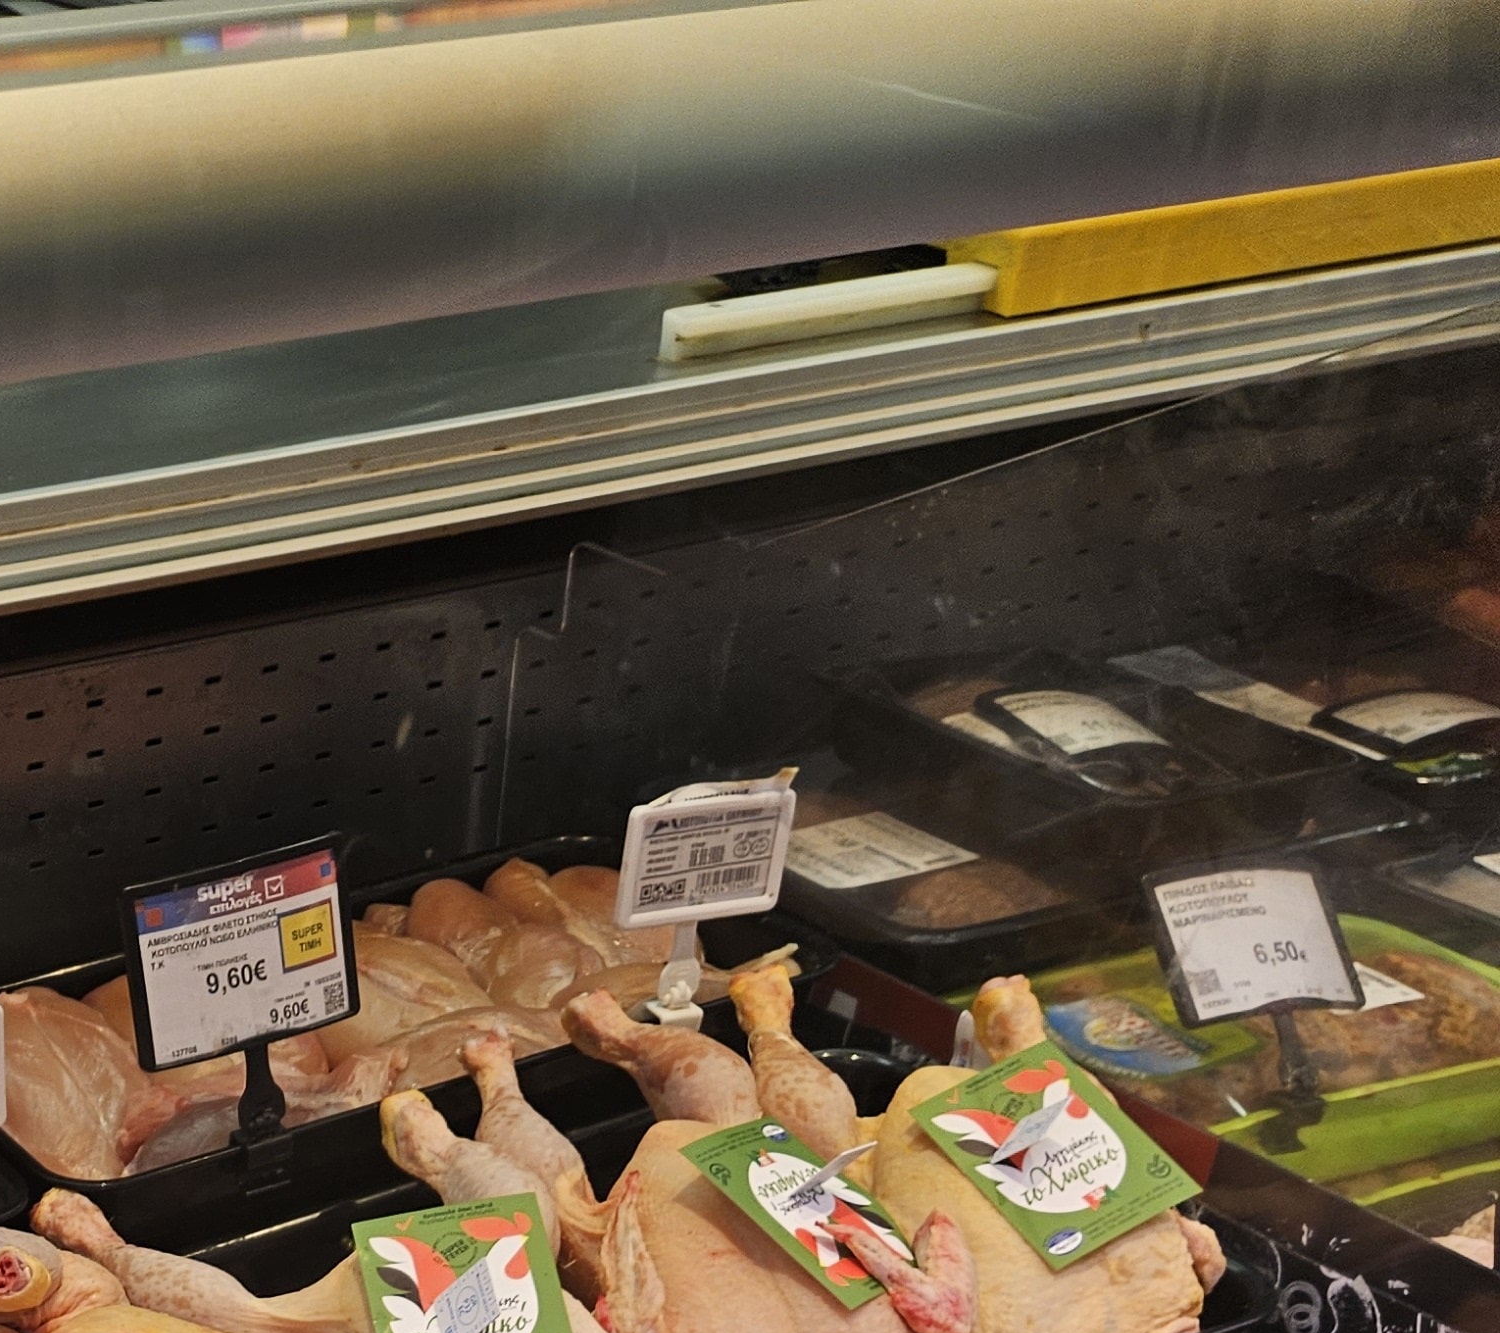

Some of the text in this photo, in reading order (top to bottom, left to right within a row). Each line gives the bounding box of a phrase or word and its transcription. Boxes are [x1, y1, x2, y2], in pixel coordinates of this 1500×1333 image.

[197, 874, 254, 902] super
[210, 892, 262, 914] επιλογές
[213, 918, 245, 934] ΦΙΛΕΤΟ
[291, 923, 324, 942] SUPER
[151, 937, 208, 959] ΚΟΤΟΠΟΥΛΟ
[299, 939, 322, 953] ΤΙΜΗ
[1253, 940, 1308, 967] 6,50€
[206, 959, 268, 996] 9,60€
[270, 998, 309, 1024] 9,60€
